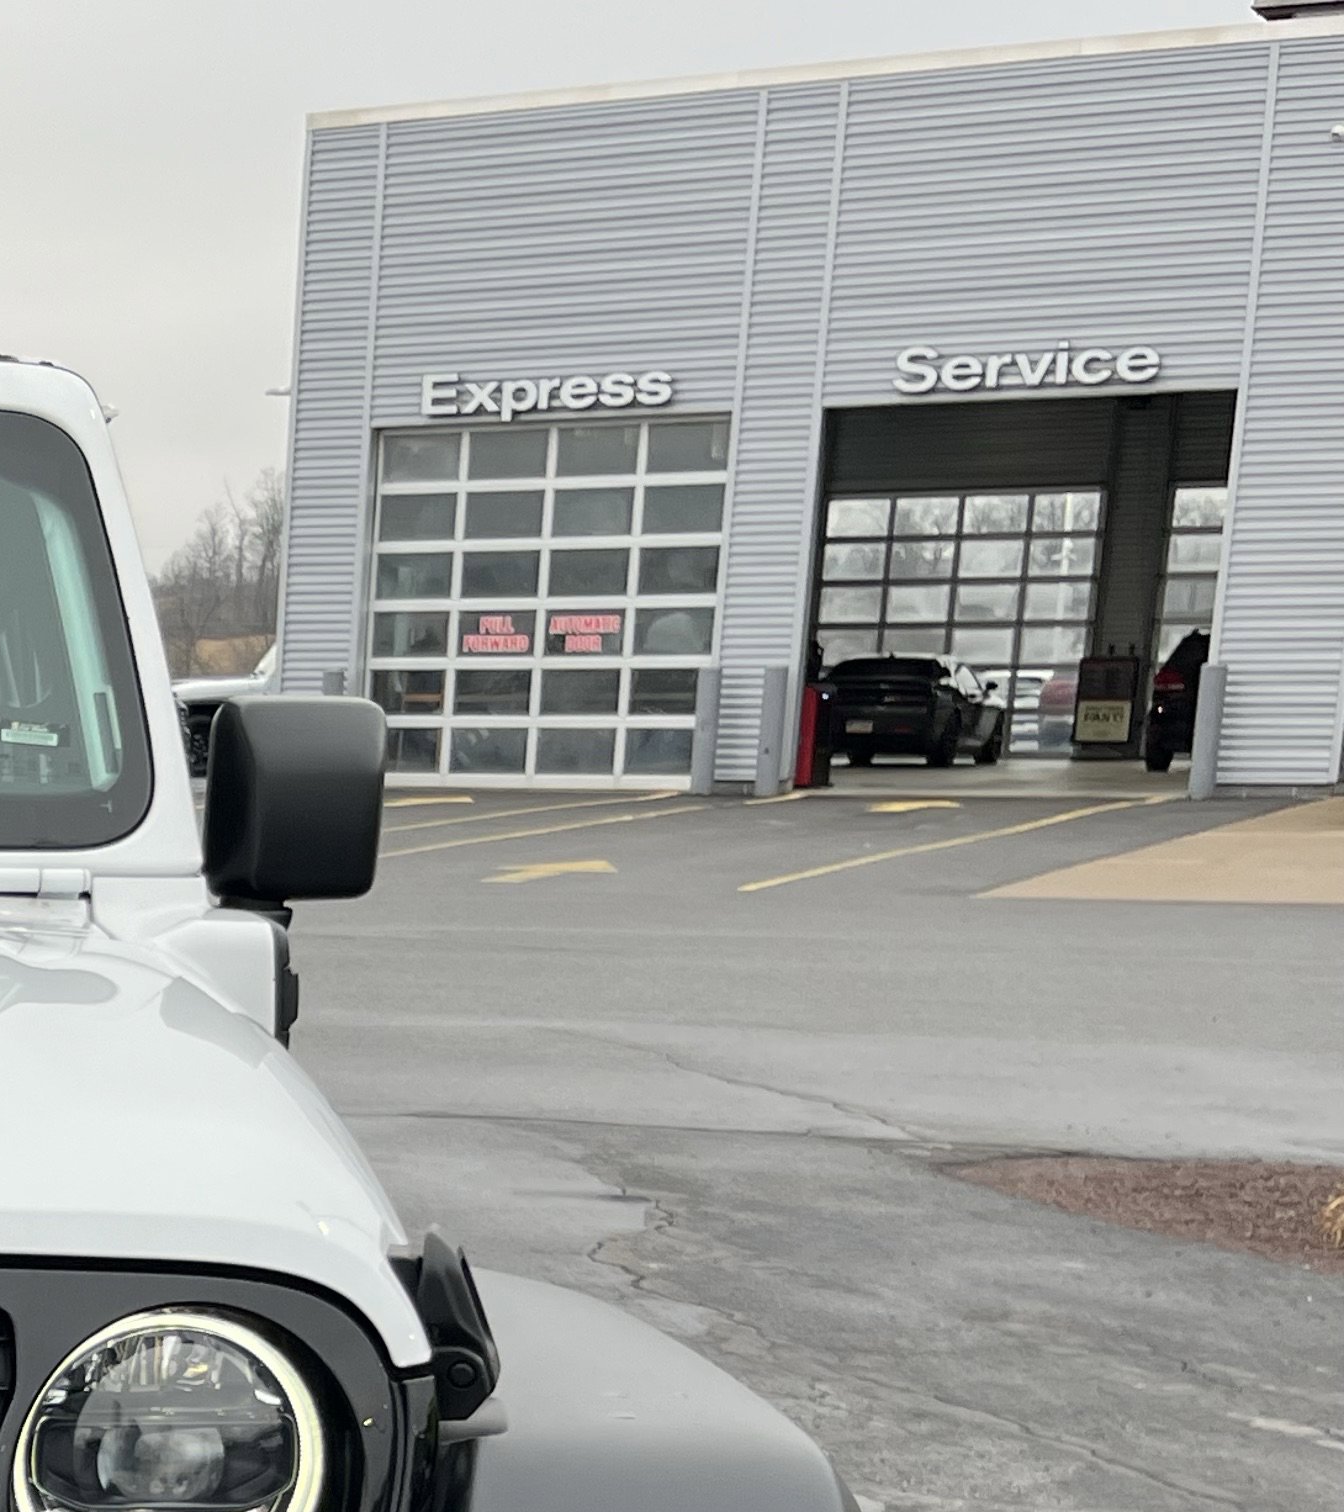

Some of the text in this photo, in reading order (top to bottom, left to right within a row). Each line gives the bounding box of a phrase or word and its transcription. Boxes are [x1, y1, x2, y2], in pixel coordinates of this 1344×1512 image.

[892, 340, 1160, 394] Service
[421, 371, 673, 422] Express
[463, 635, 529, 652] FORWARD
